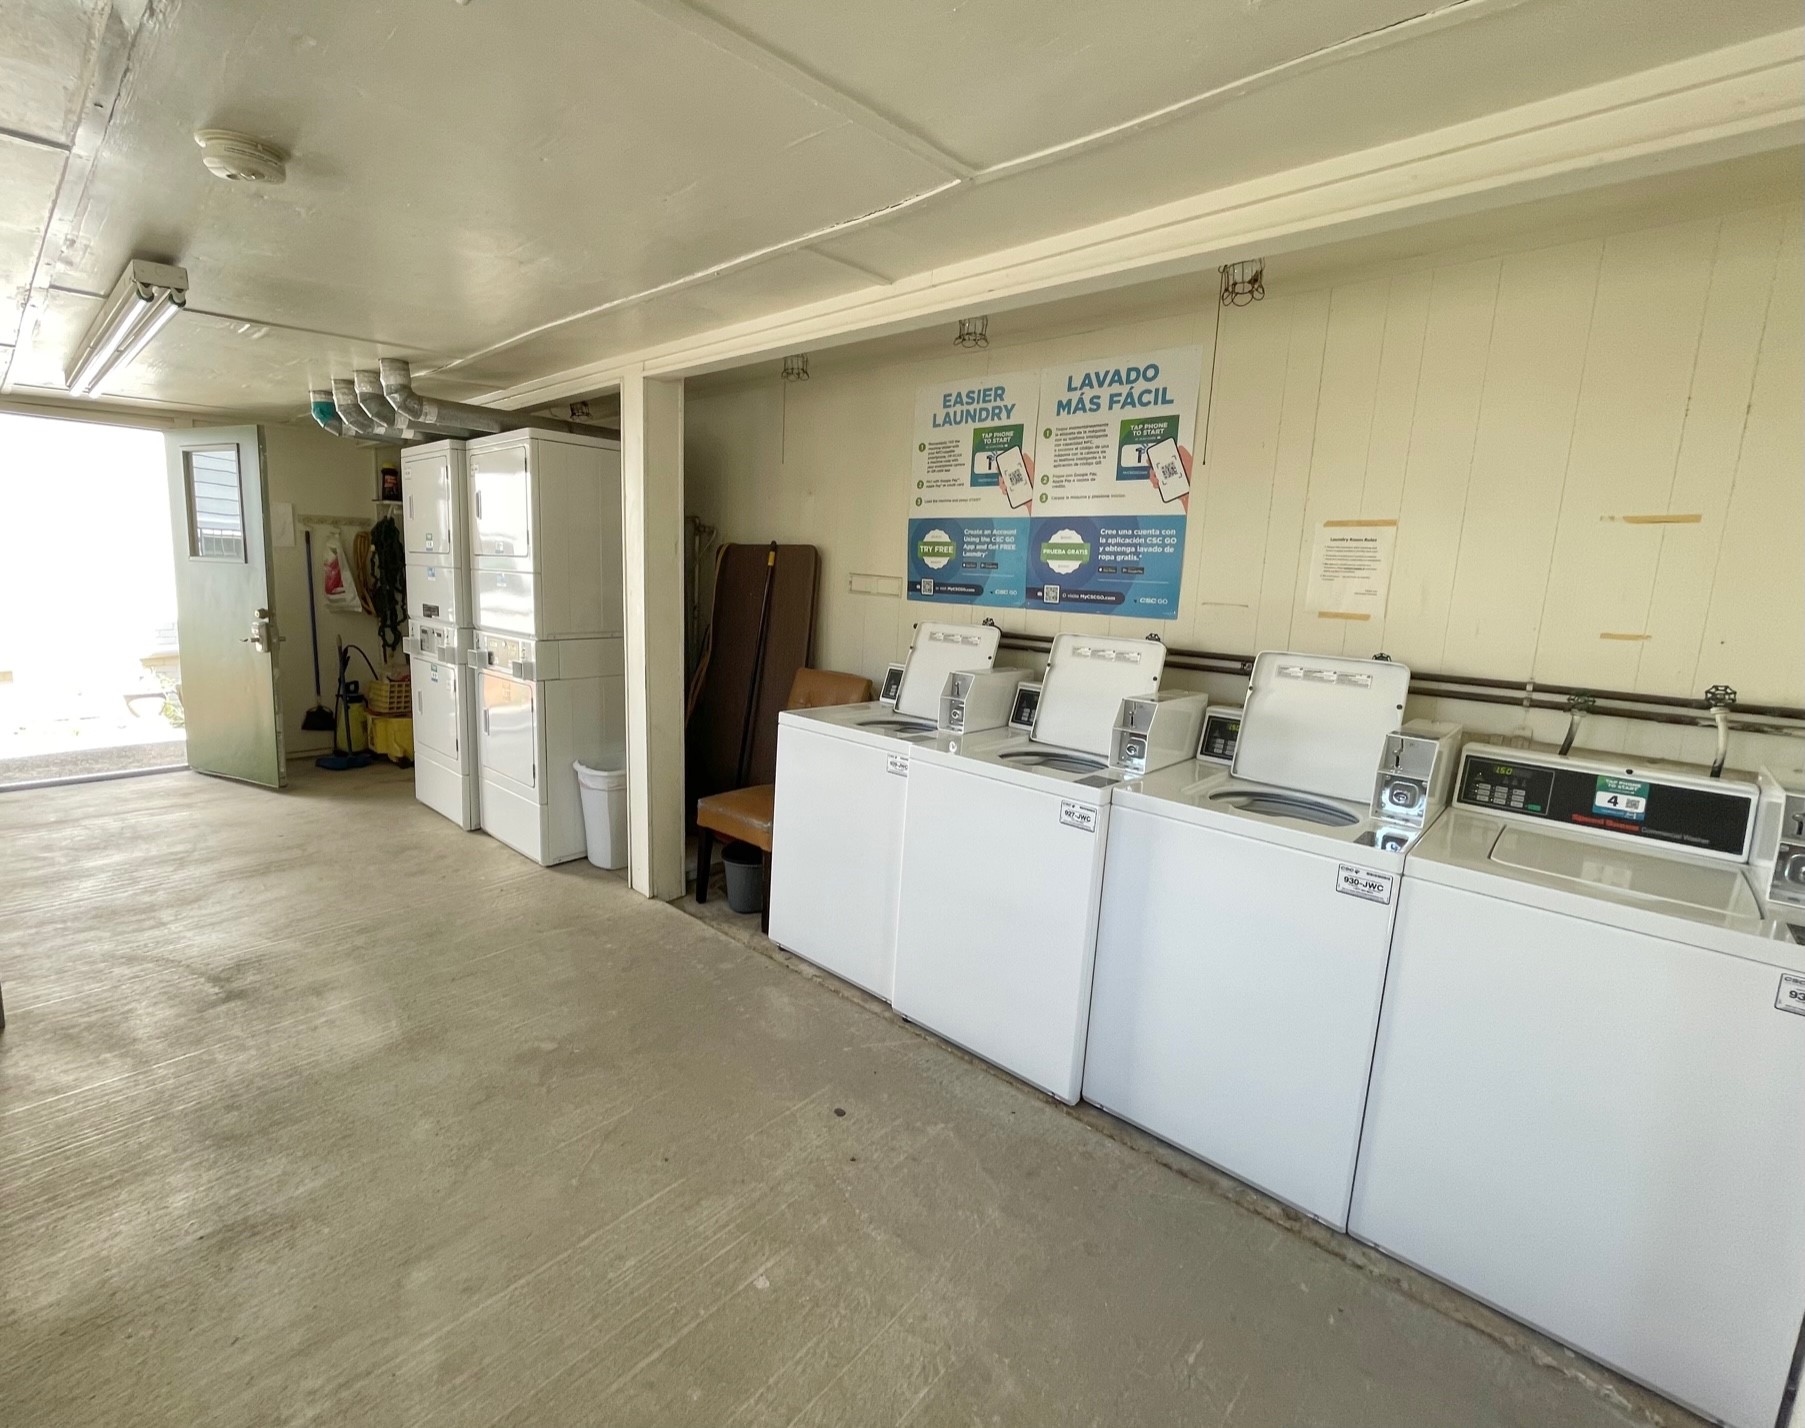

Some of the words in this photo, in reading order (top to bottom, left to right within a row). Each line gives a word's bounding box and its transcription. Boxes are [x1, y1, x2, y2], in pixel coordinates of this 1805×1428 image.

[1067, 364, 1160, 392] LAVADO
[942, 386, 1006, 408] EASIER
[1056, 392, 1101, 416] MÁS
[1108, 386, 1174, 410] FÁCIL
[932, 404, 1016, 428] LAUNDRY
[1105, 546, 1135, 554] obtenga
[1607, 795, 1618, 807] 4
[1344, 876, 1384, 891] 930-JWC
